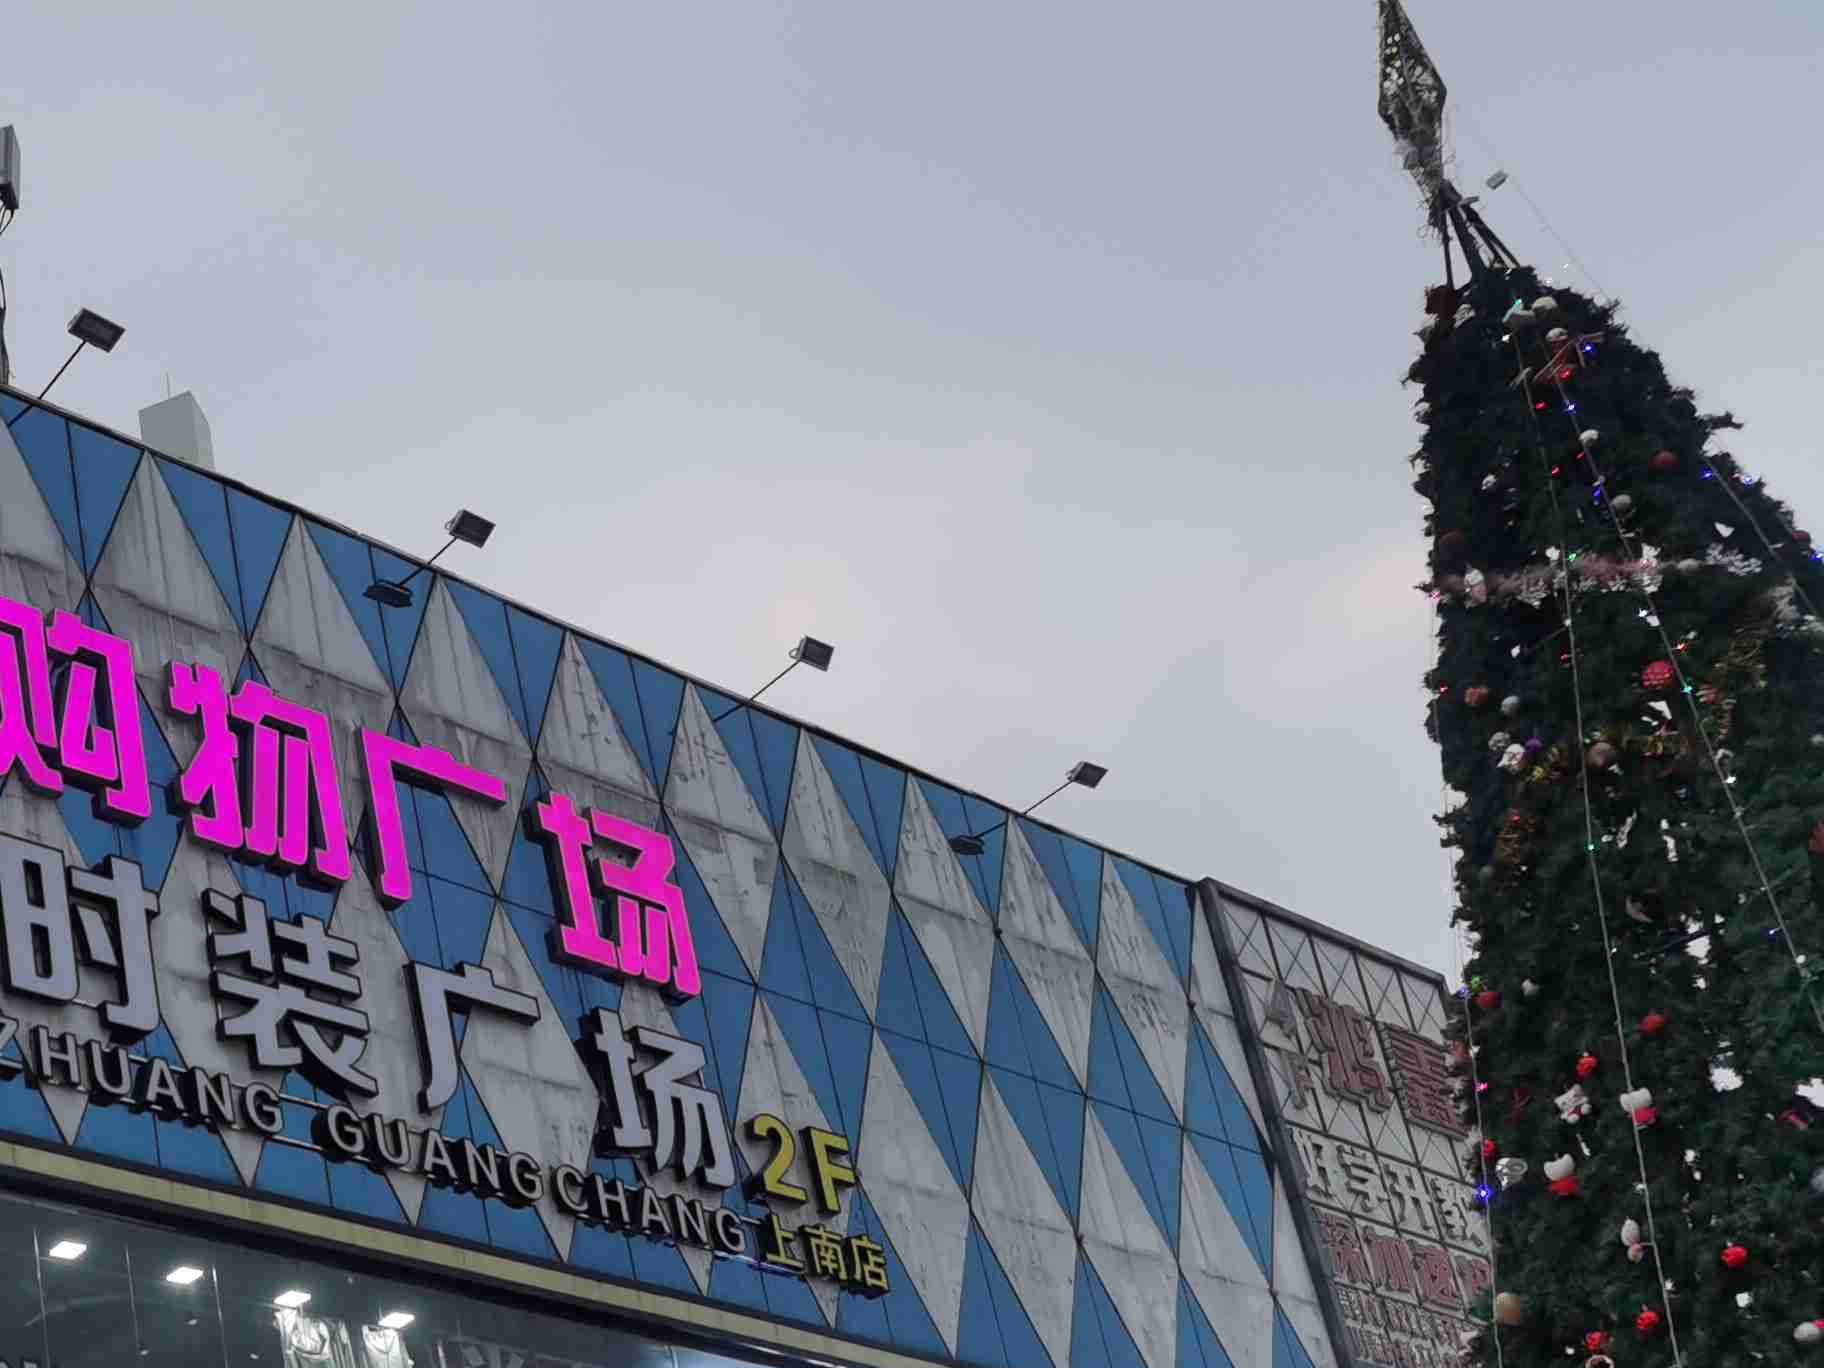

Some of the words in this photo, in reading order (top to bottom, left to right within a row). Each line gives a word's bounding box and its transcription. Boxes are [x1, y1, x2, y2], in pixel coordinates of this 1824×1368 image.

[748, 1113, 857, 1217] 2F
[756, 1211, 890, 1297] 上南店
